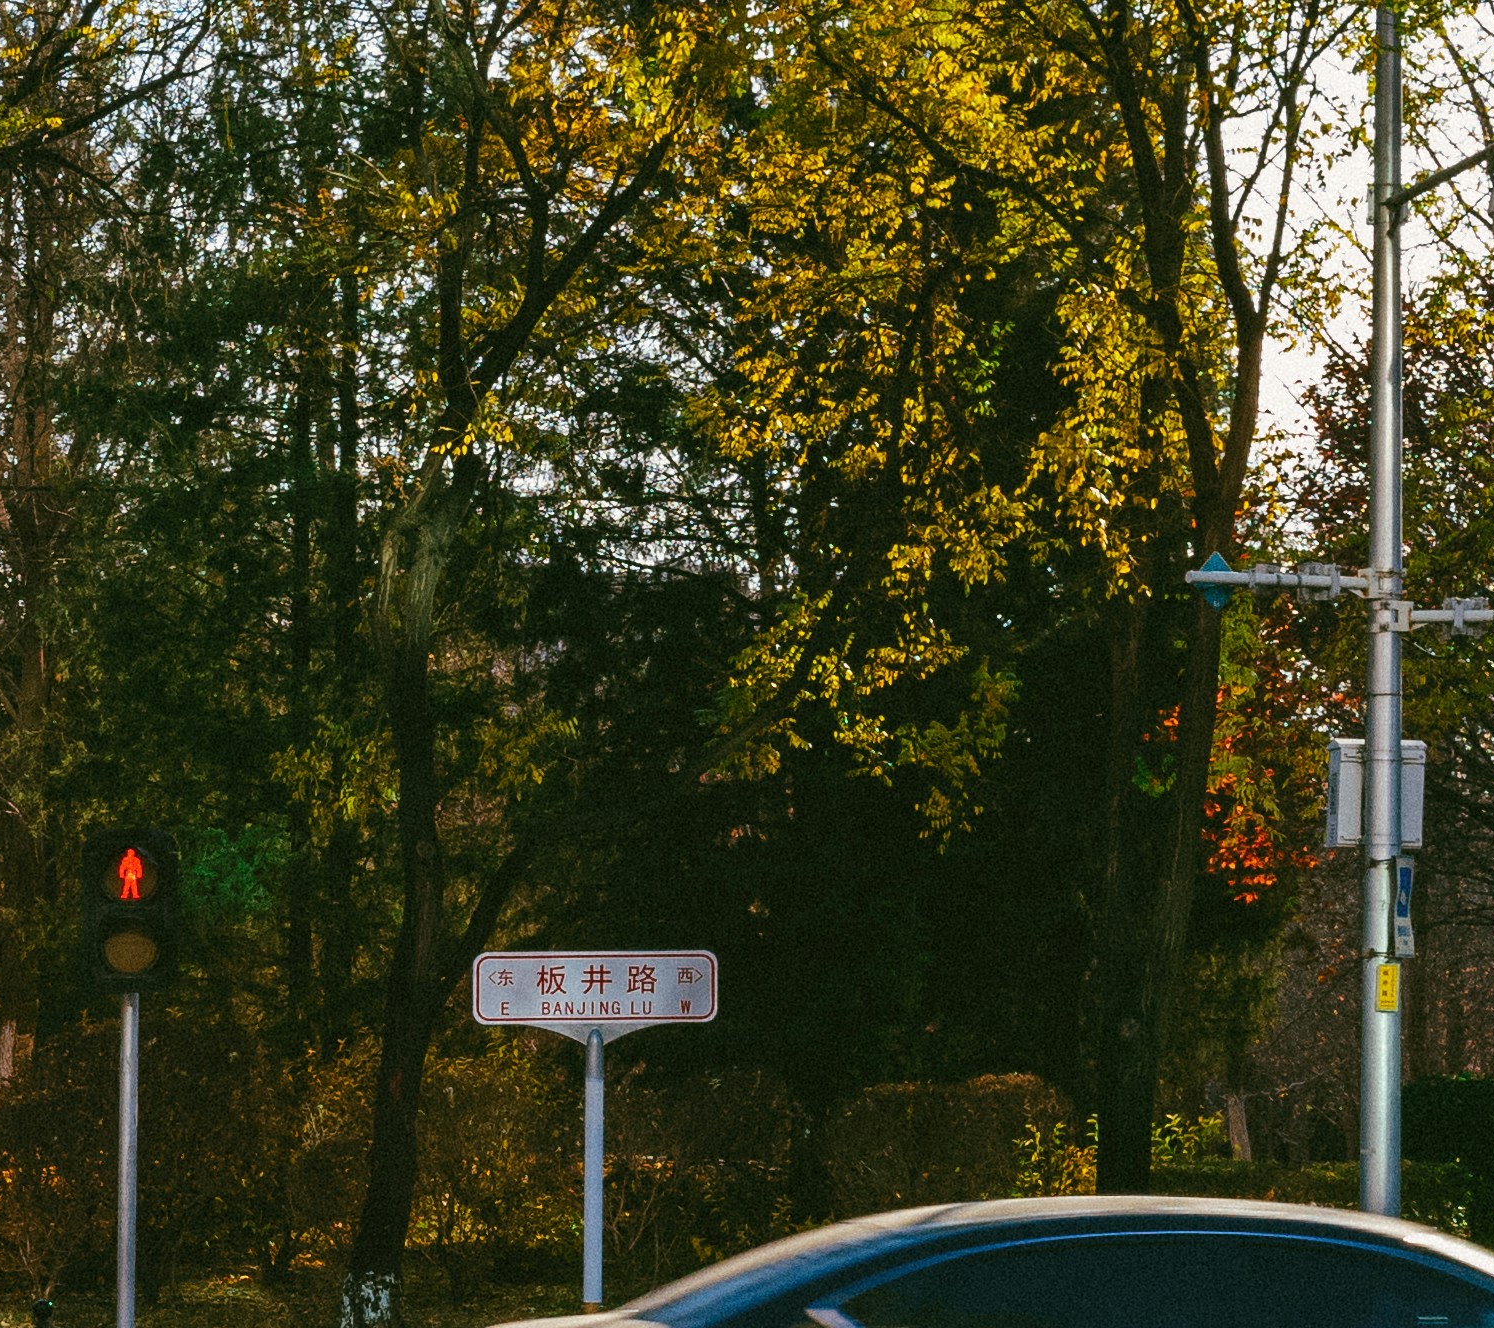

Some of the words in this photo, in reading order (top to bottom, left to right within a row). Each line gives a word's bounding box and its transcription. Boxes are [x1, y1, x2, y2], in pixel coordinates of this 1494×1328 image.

[496, 968, 514, 987] 东
[536, 964, 658, 995] 板井路
[676, 967, 694, 985] 西
[500, 1001, 510, 1016] E
[541, 1001, 621, 1016] BANJING
[630, 1000, 653, 1015] LU
[679, 999, 692, 1014] W
